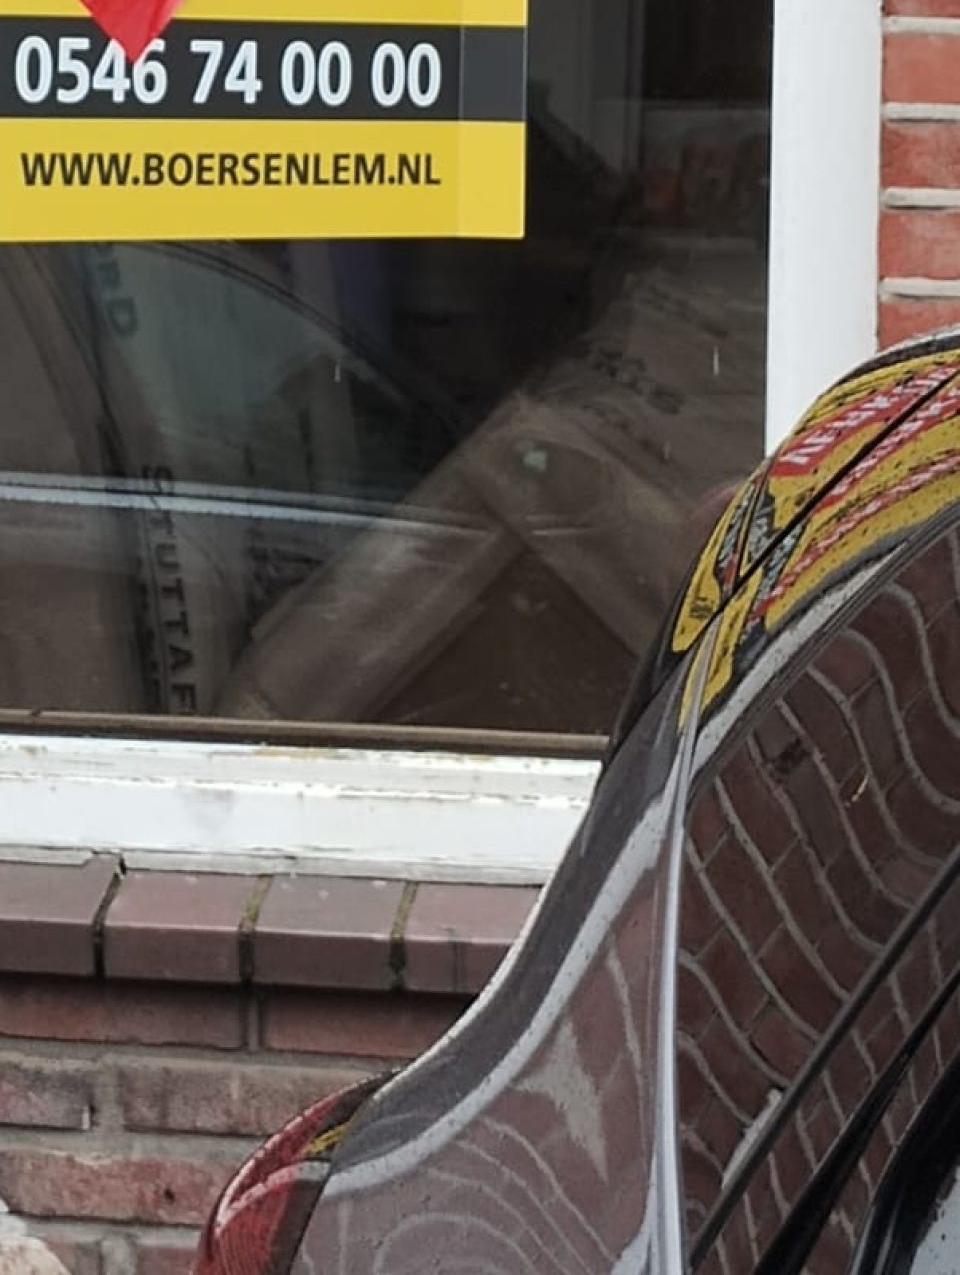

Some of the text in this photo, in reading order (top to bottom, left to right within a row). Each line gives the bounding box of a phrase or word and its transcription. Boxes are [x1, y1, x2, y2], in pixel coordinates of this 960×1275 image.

[15, 36, 442, 107] 0546 74 00 00
[21, 152, 441, 186] WWW.BOERSENLEM.NL
[141, 465, 198, 714] STUTTAF
